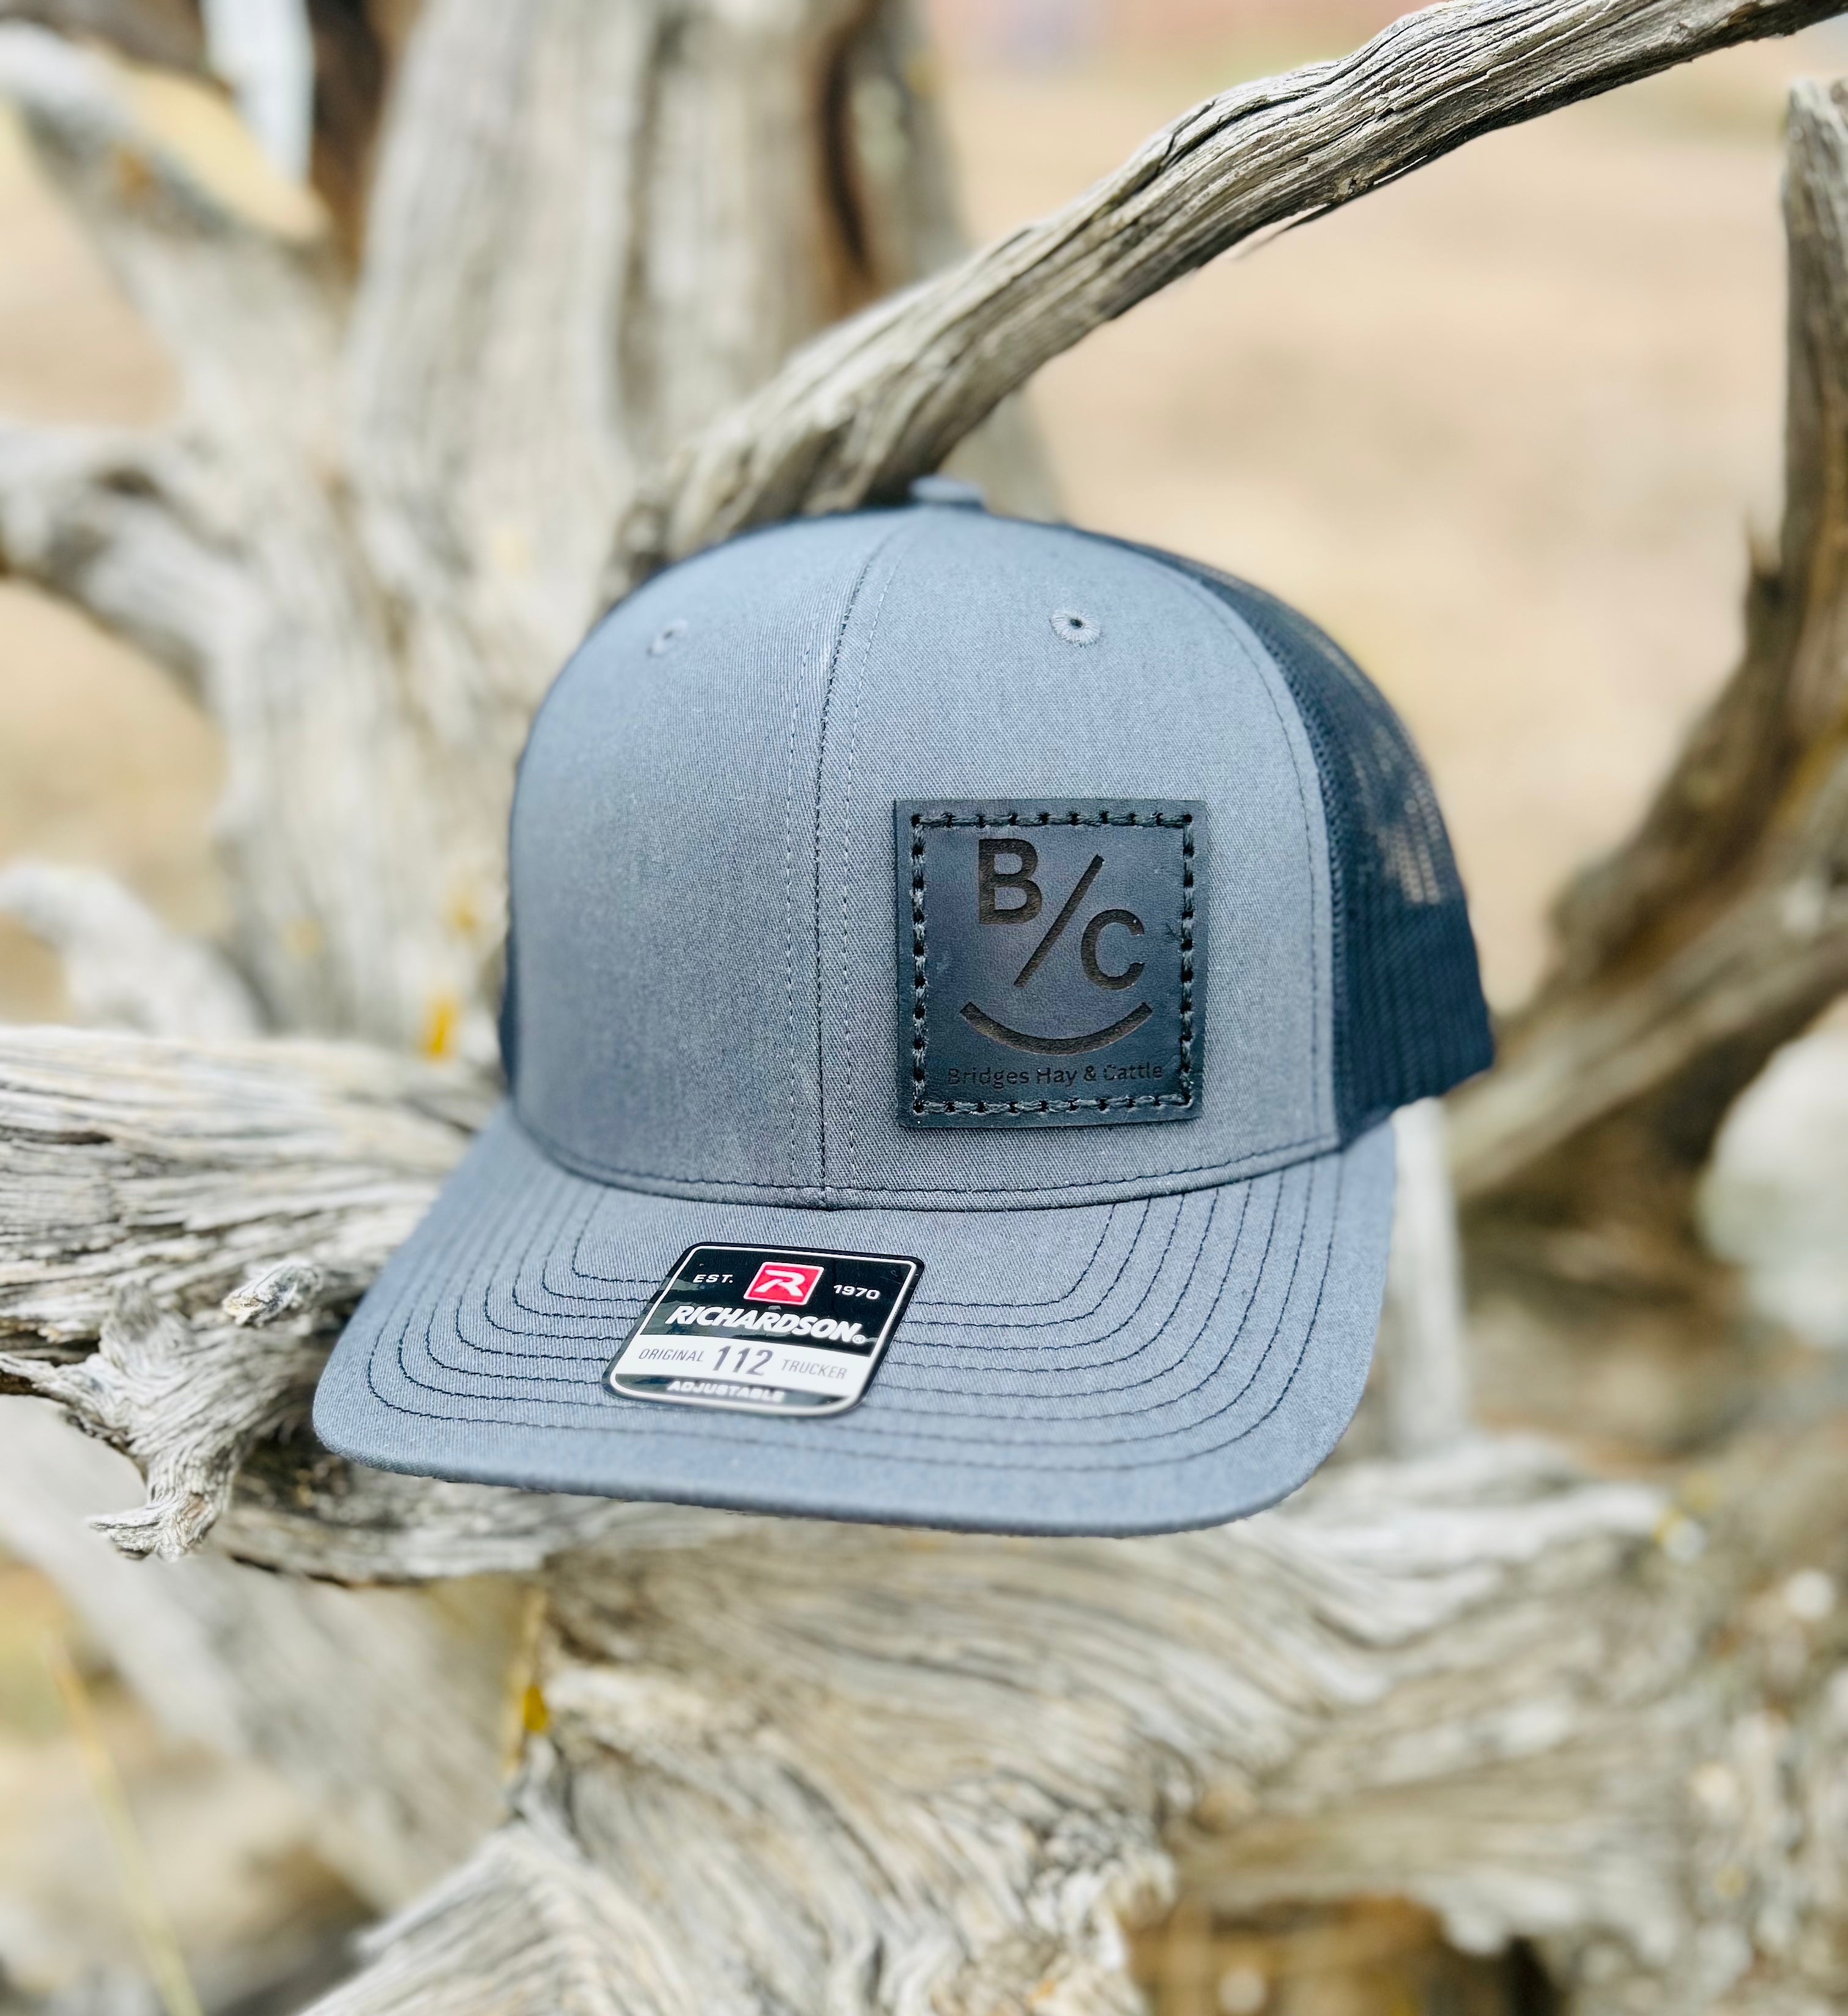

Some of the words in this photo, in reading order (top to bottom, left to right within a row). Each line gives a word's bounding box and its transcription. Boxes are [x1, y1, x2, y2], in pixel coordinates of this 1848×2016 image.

[948, 1067, 1030, 1089] Bridges
[1037, 1068, 1077, 1087] Hay
[1083, 1065, 1096, 1080] &
[1104, 1062, 1162, 1080] Cattle
[692, 1273, 733, 1284] EST.
[833, 1284, 881, 1300] 1970
[638, 1348, 704, 1362] ORIGINAL
[710, 1345, 773, 1376] 112
[781, 1359, 848, 1380] TRUCKER
[667, 1380, 785, 1401] ADJUSTABLE
